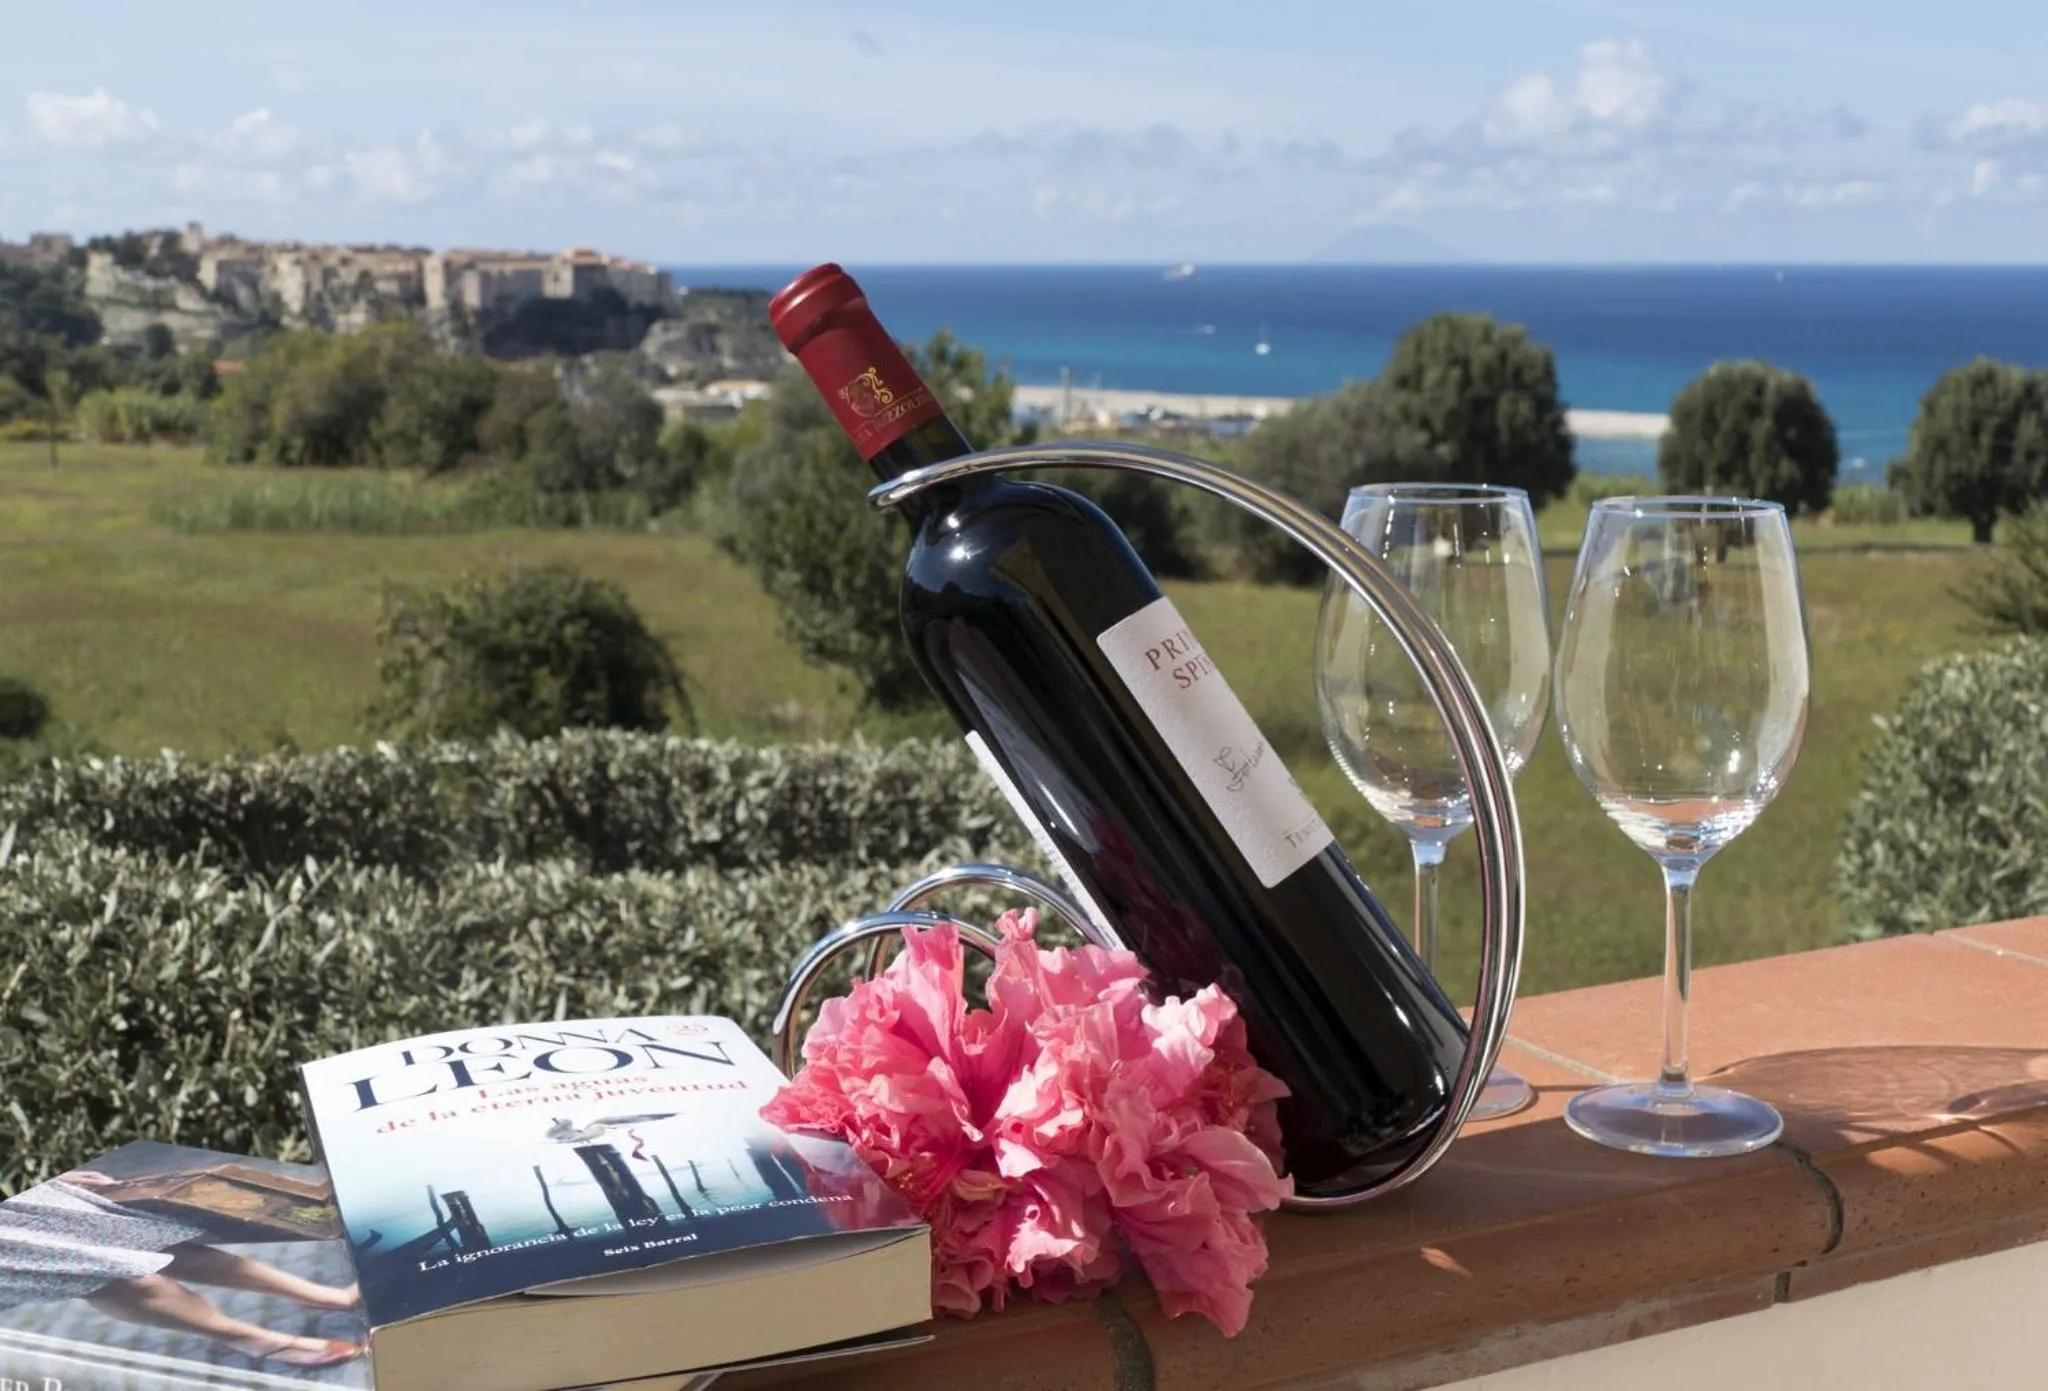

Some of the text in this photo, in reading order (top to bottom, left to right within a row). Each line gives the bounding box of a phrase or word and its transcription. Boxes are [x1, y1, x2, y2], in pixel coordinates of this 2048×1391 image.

[401, 1027, 659, 1066] DONNA
[376, 1079, 749, 1134] de la eterna juventud
[477, 1076, 648, 1100] Las aguas
[417, 1194, 854, 1272] La ignorancia de la ley es la peor condena
[602, 1232, 700, 1258] Seix Barral
